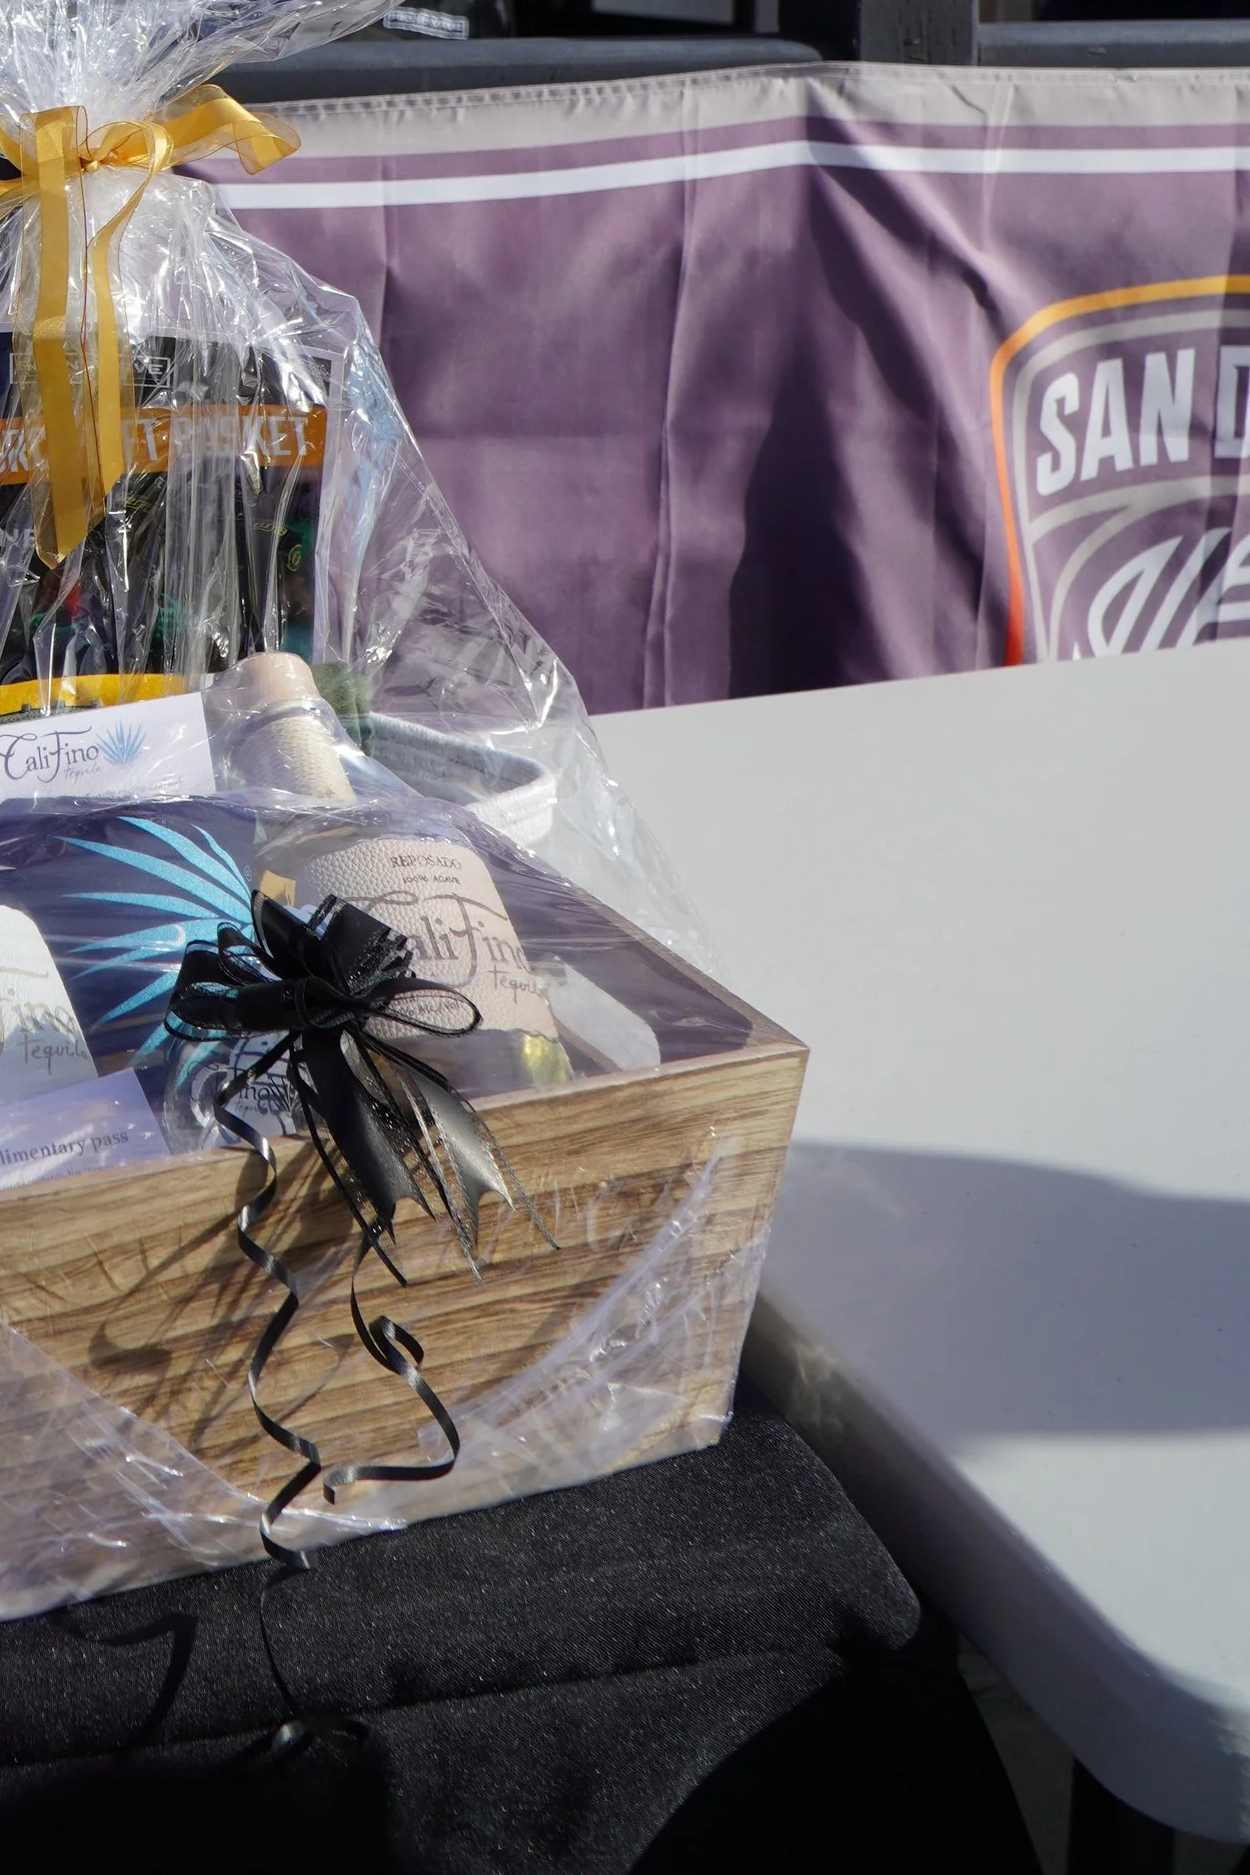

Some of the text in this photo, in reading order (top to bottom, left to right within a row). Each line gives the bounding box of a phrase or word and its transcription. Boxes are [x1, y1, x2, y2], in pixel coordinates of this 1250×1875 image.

[1036, 343, 1250, 496] SAN D
[390, 855, 463, 870] REPOSADO
[433, 875, 461, 885] AGAVE
[90, 1131, 129, 1151] pass
